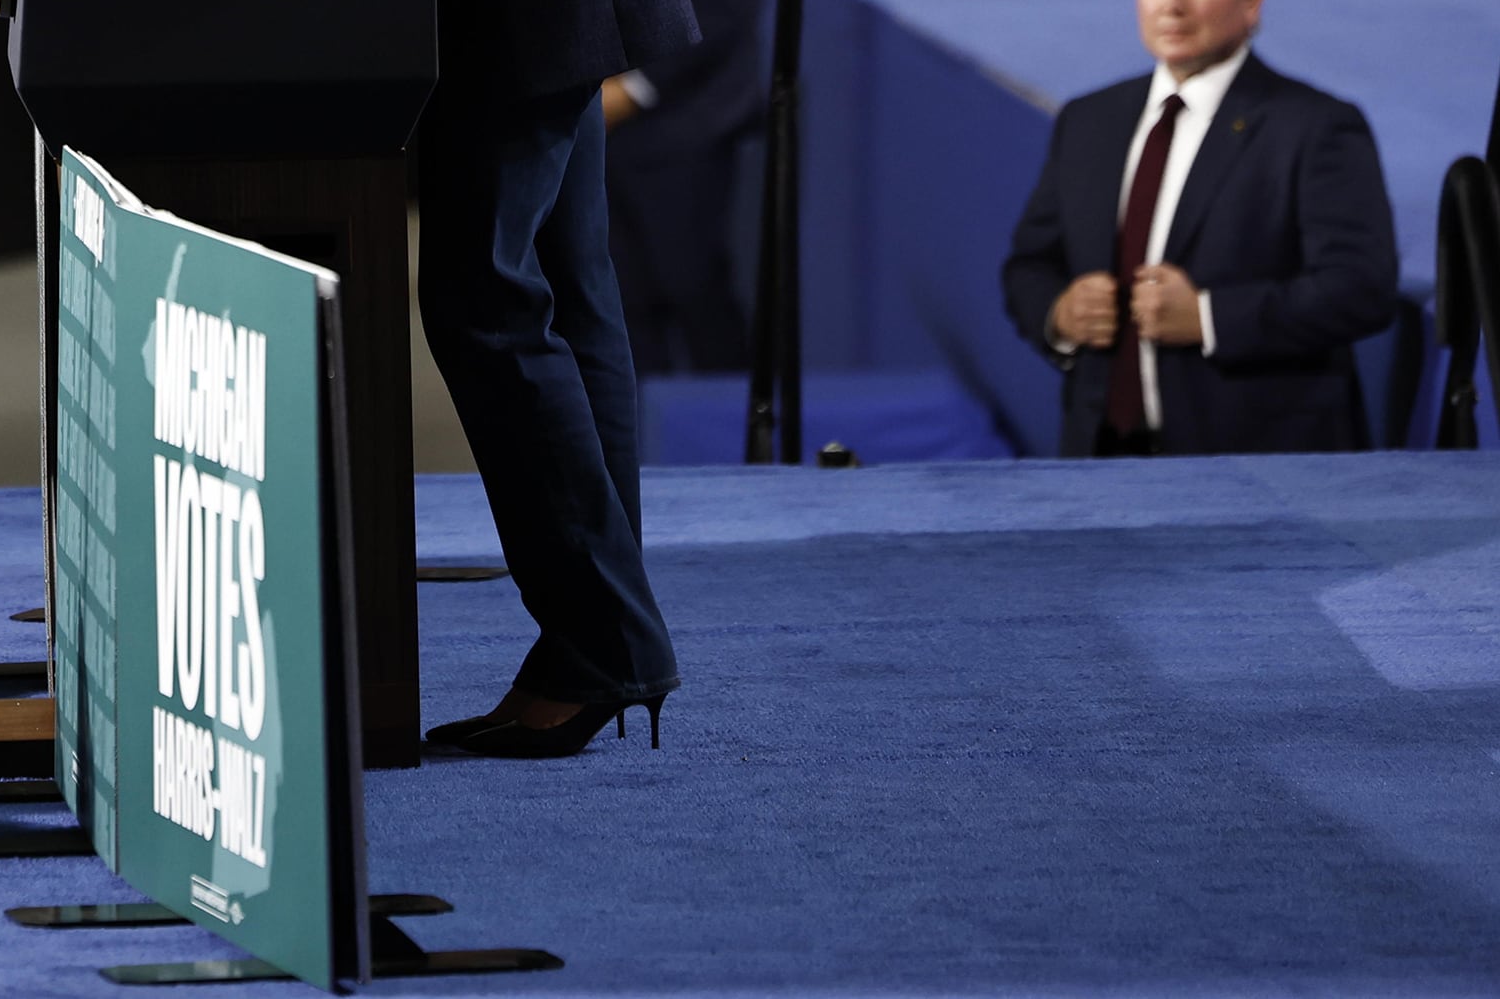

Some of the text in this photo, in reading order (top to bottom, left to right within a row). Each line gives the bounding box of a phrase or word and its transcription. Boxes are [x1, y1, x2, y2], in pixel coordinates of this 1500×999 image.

[153, 297, 266, 482] MICHIGAN
[153, 453, 266, 742] VOTES
[153, 705, 267, 868] HARRIS-WALZ
